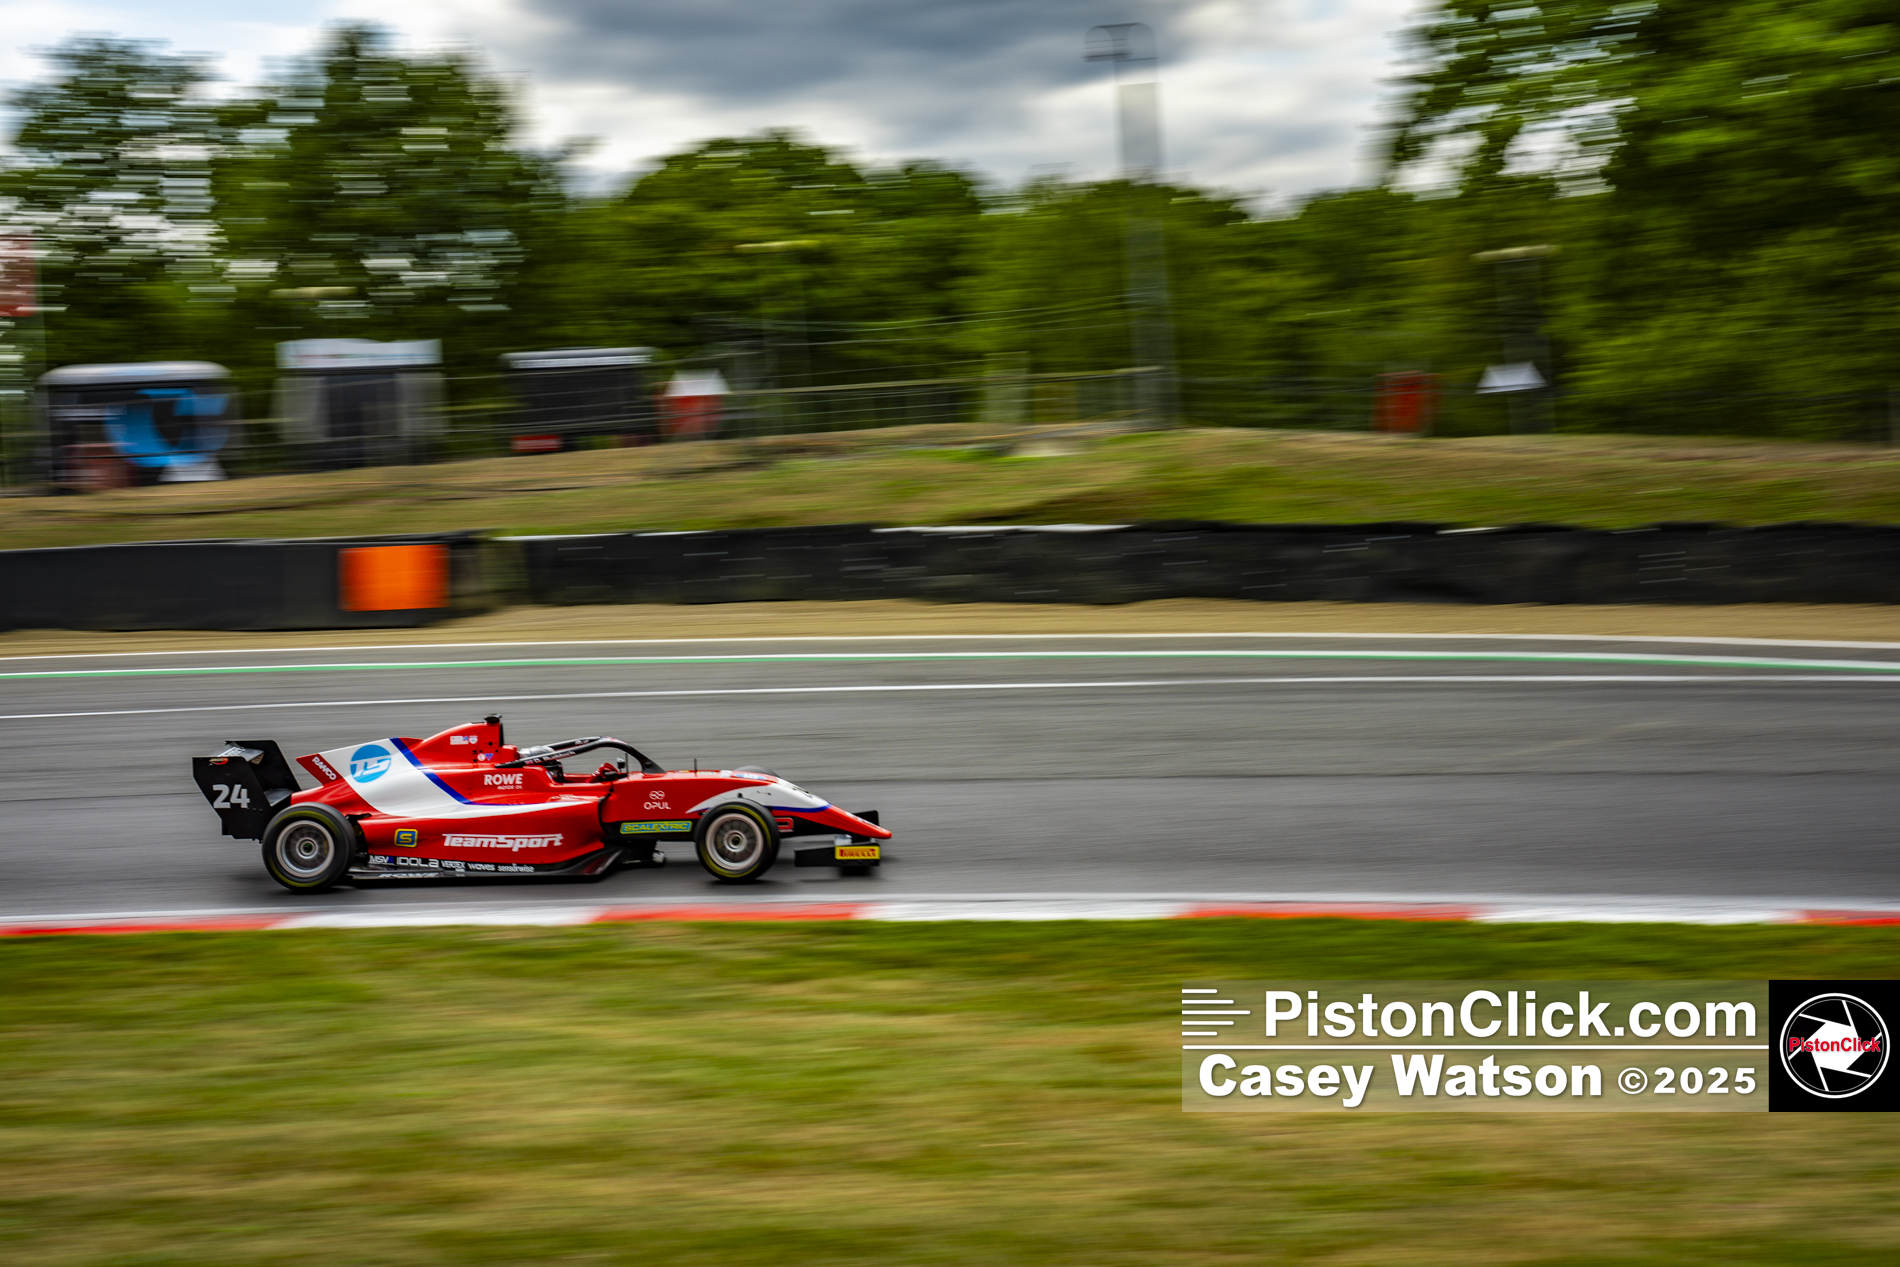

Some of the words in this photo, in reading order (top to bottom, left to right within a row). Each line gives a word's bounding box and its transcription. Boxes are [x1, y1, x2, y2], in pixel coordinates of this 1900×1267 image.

[484, 773, 524, 786] ROWE
[212, 783, 251, 809] 24
[643, 801, 672, 810] OPUL
[624, 823, 688, 832] SCALEXTRIC
[442, 833, 564, 852] TeamSport
